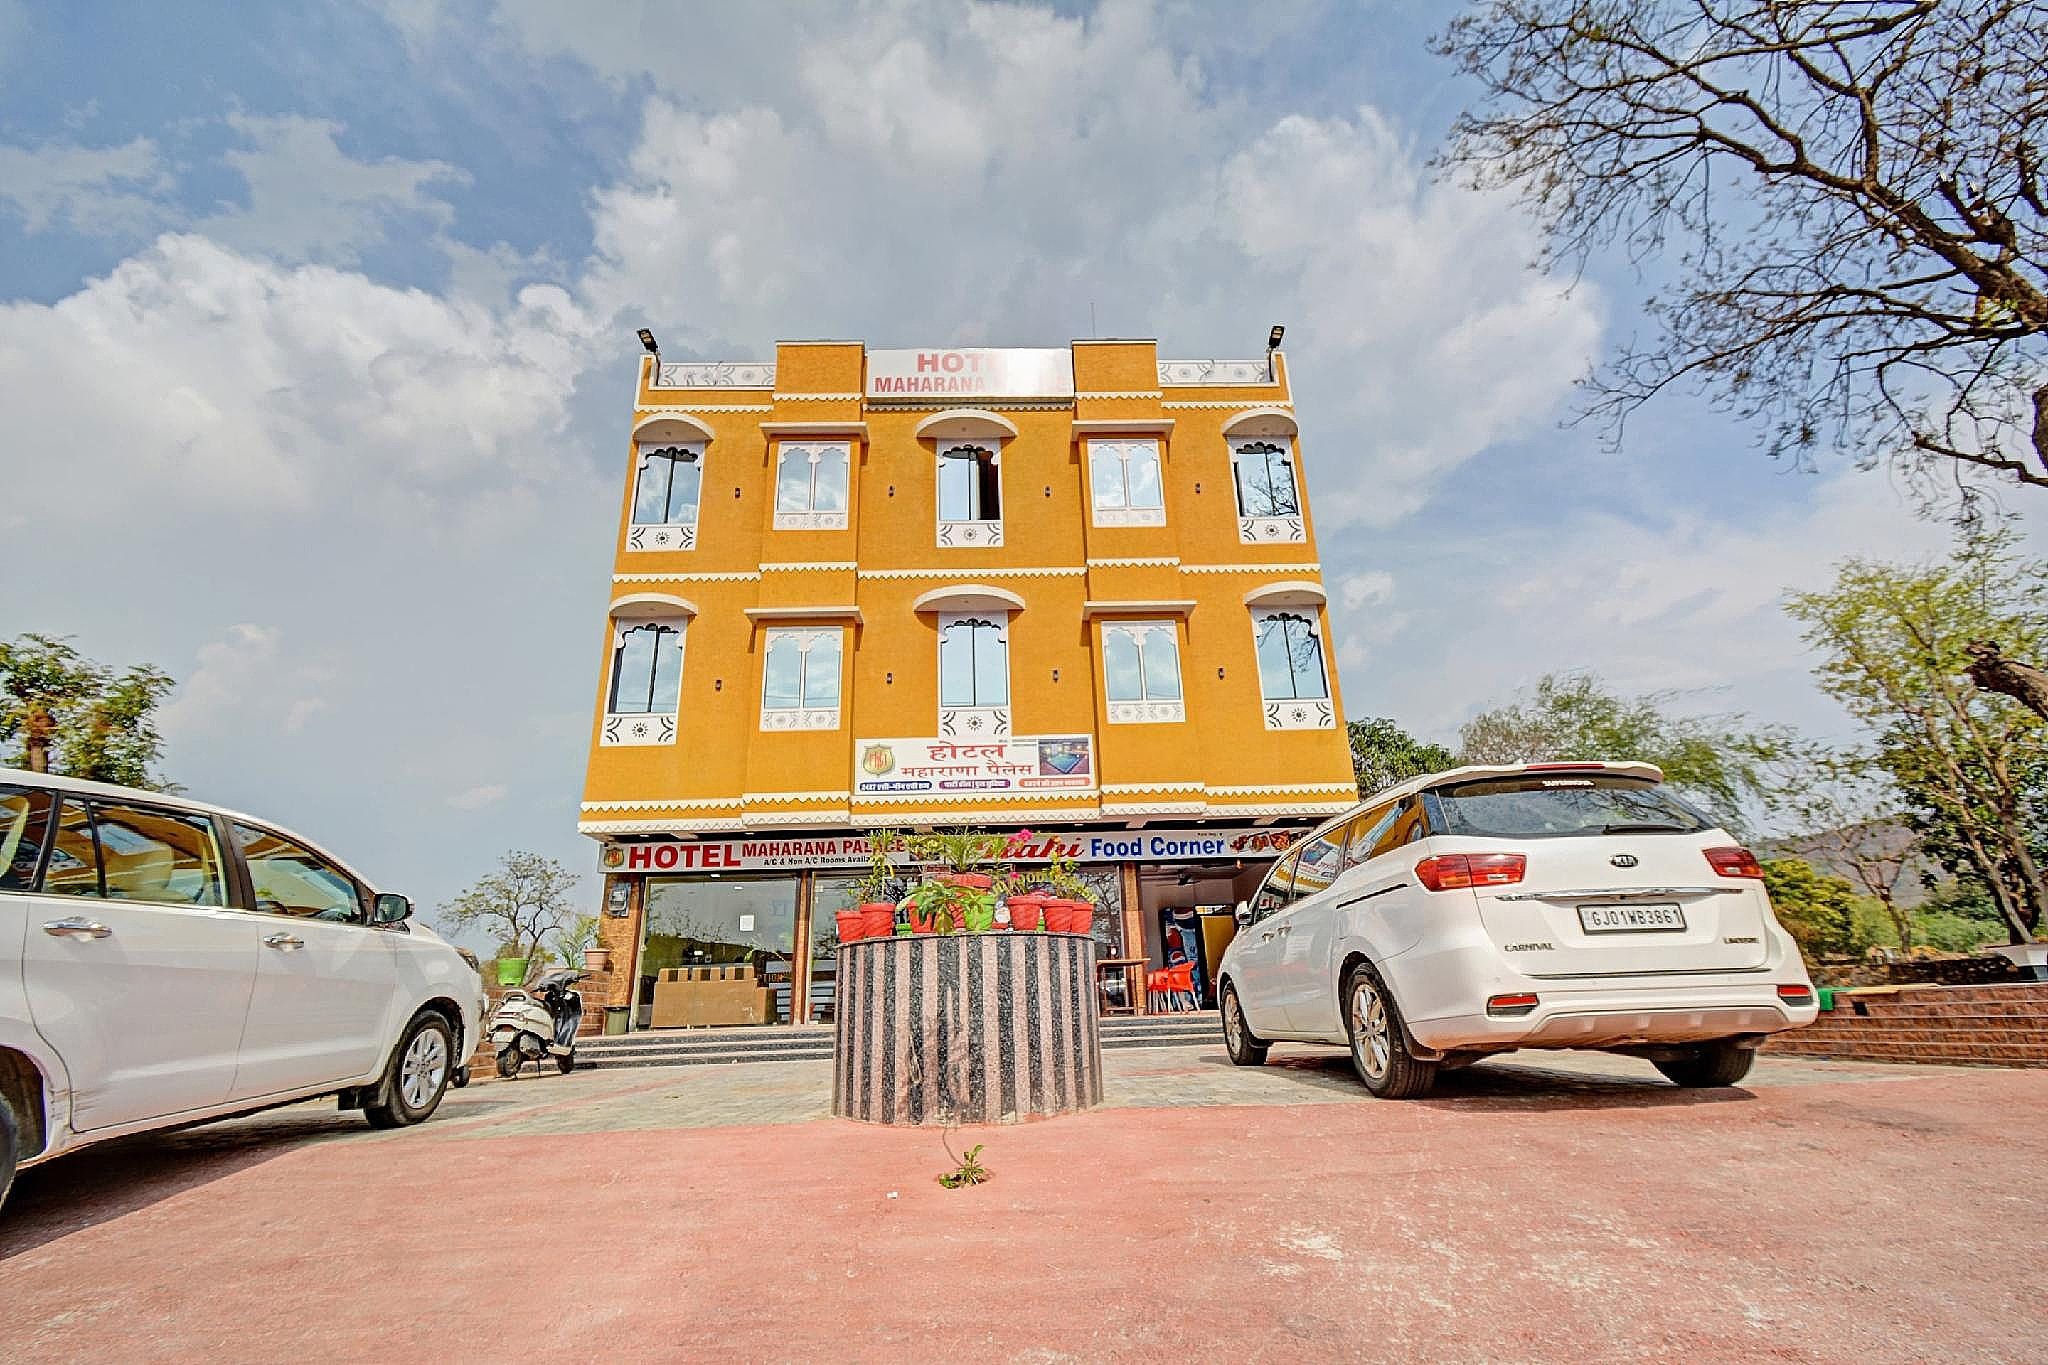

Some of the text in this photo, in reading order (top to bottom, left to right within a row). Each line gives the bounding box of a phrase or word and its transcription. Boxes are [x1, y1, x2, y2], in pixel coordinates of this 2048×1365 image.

[874, 377, 985, 393] MAHARANA
[926, 740, 1008, 762] होटल
[900, 761, 1034, 778] महाराणा पैलेस
[628, 844, 741, 869] HOTEL
[742, 840, 837, 857] MAHARANA
[1091, 837, 1142, 857] Food
[1150, 836, 1225, 856] Corner
[820, 856, 846, 864] Rooms
[1503, 942, 1556, 952] CARNIVAL
